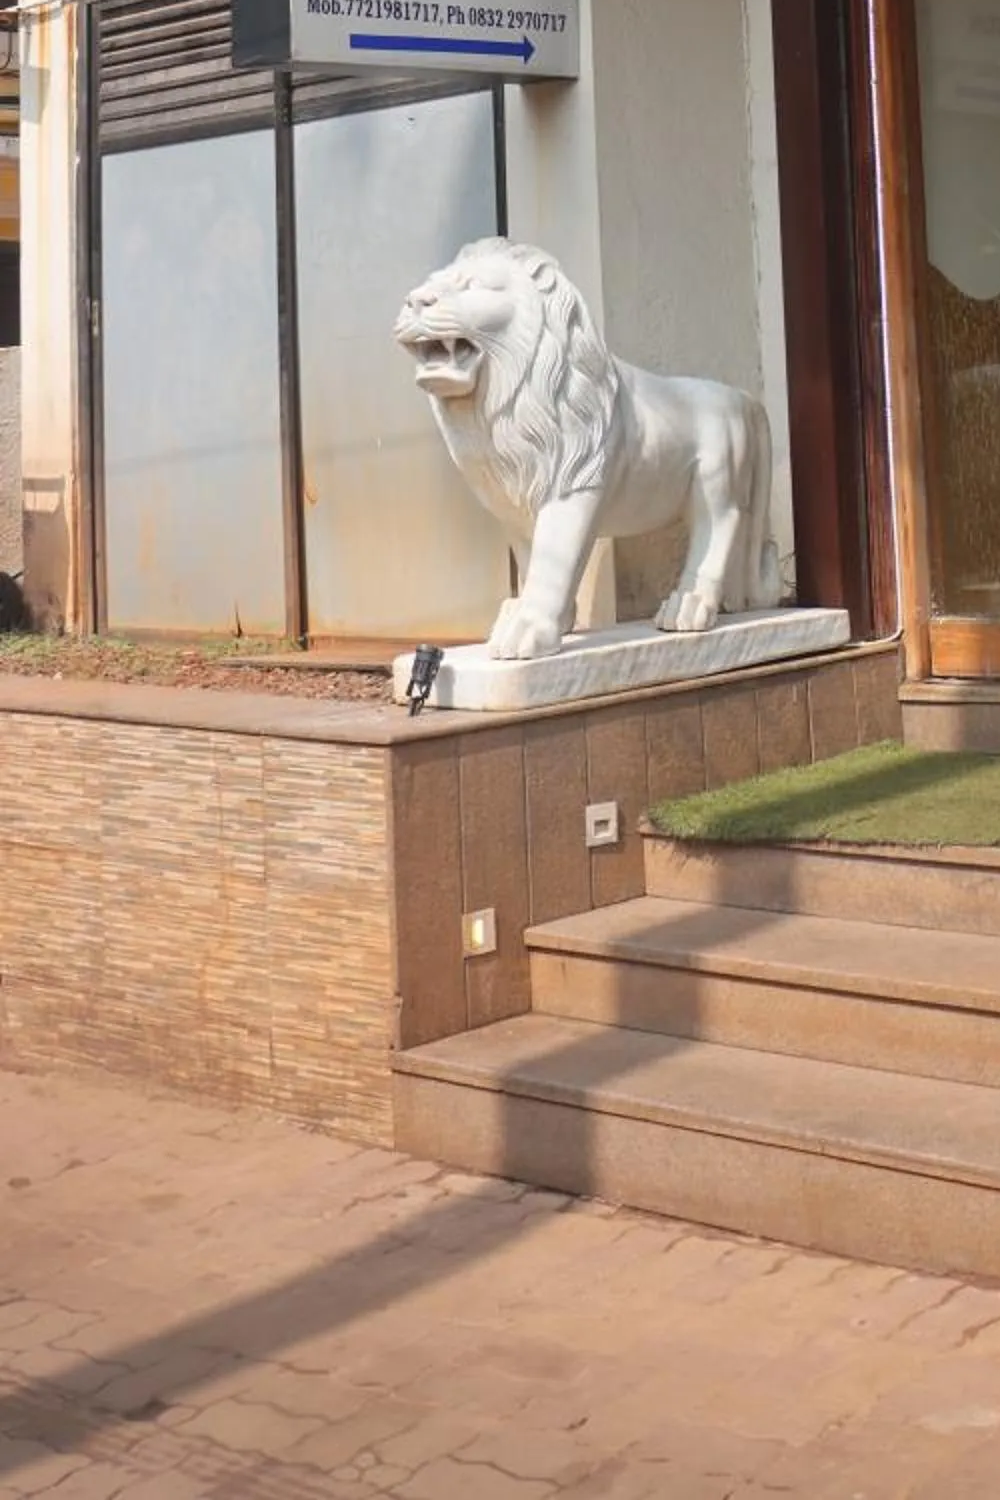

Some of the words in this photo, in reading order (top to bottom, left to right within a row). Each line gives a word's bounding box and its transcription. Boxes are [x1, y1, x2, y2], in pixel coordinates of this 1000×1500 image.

[446, 5, 465, 25] Ph
[469, 8, 503, 28] 0832
[507, 10, 567, 32] 2970717
